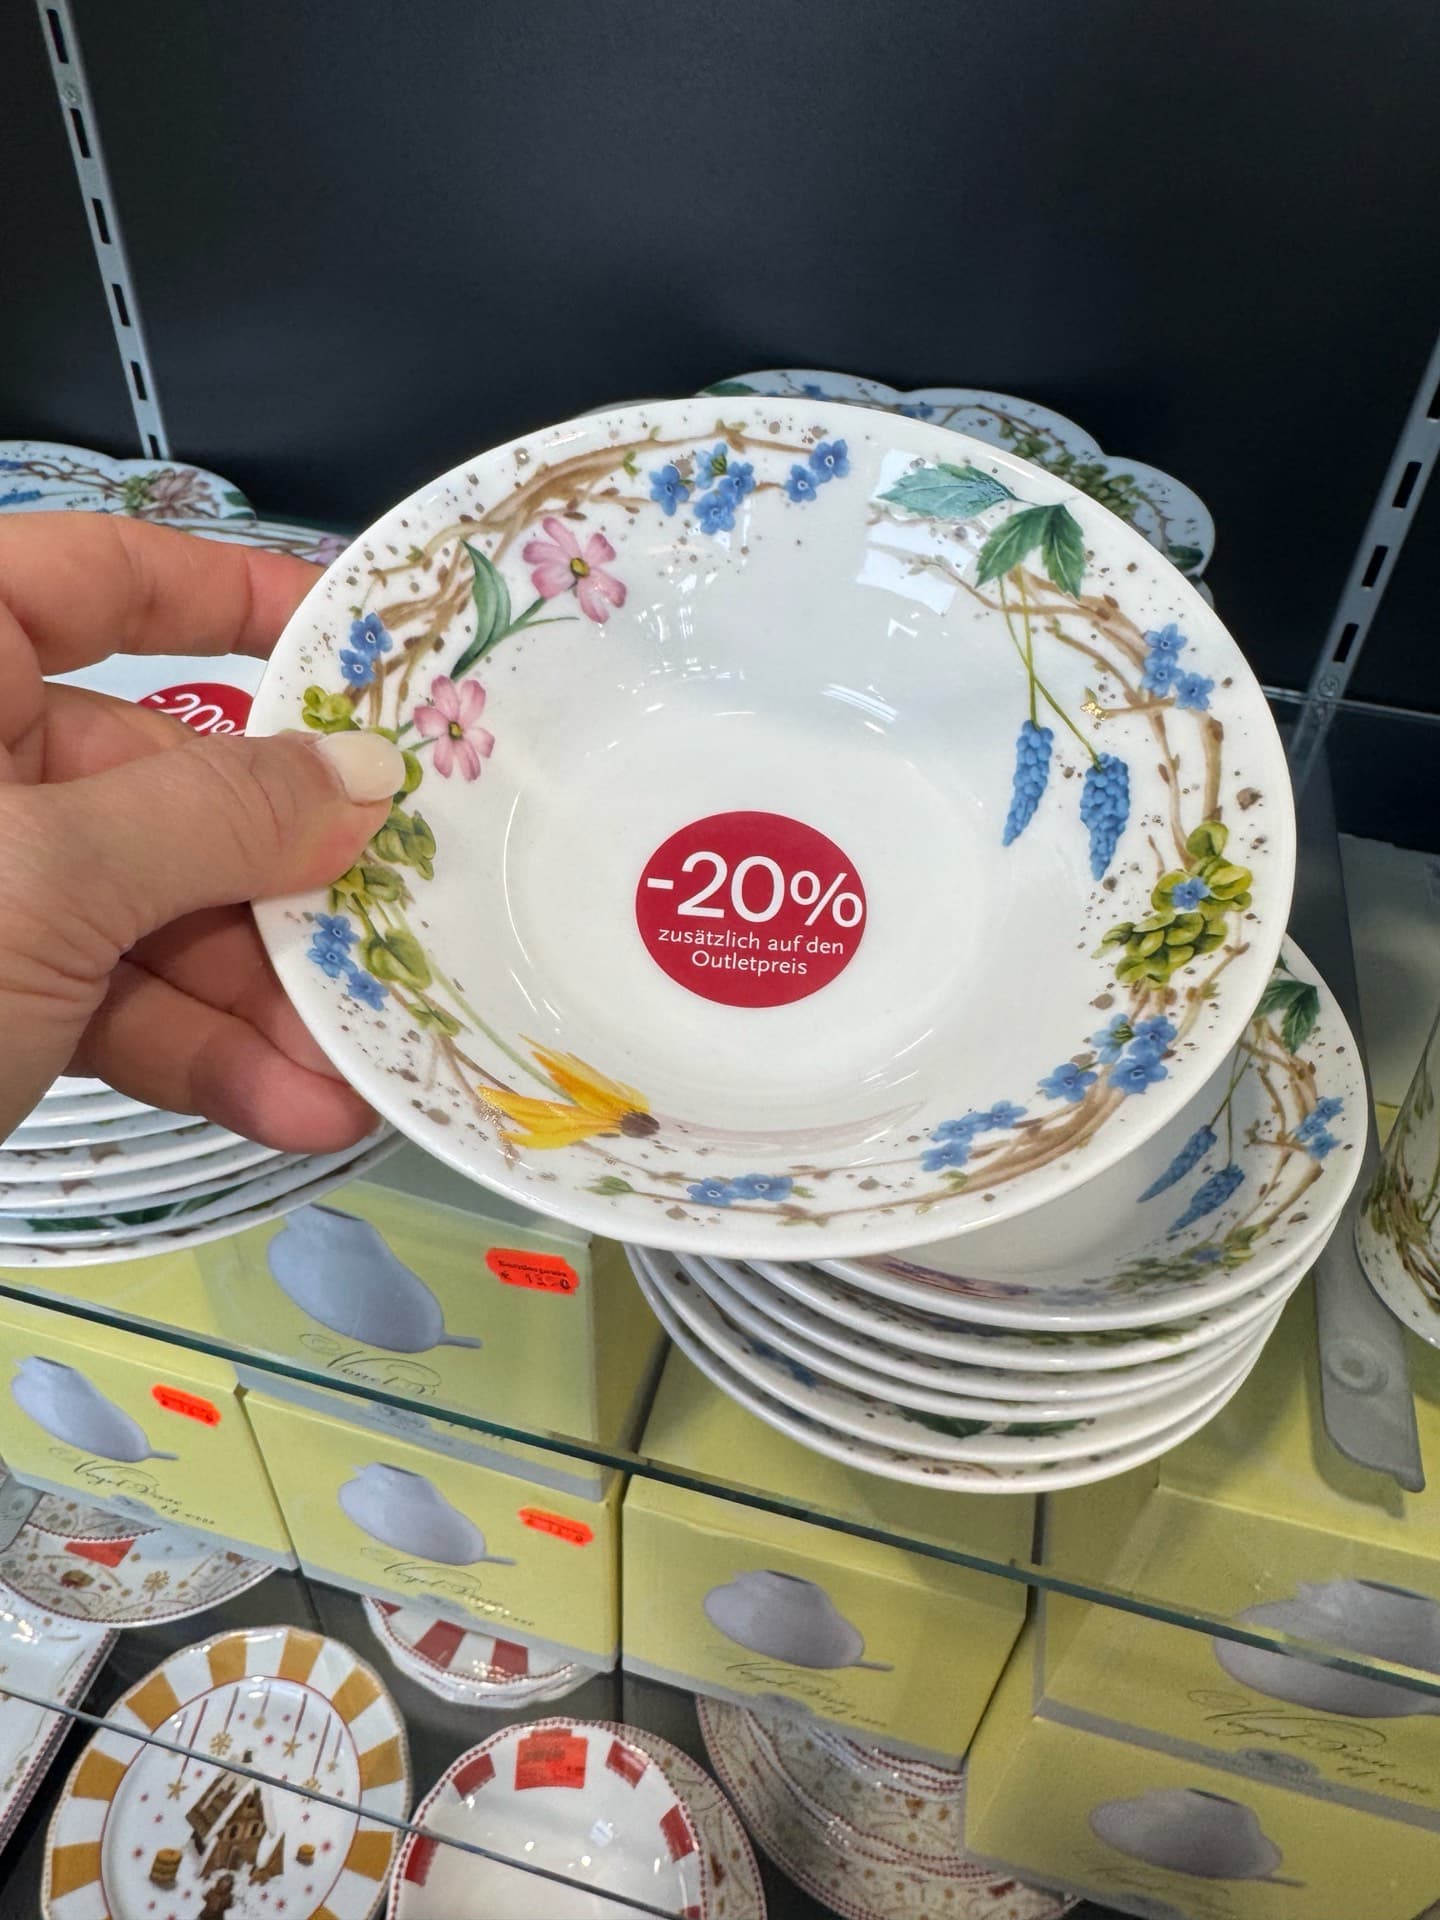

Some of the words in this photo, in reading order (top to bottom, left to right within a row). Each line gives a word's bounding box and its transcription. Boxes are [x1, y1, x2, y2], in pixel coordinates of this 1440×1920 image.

[646, 850, 864, 928] -20%
[658, 928, 760, 950] zusätzlich
[767, 934, 804, 952] auf
[806, 935, 845, 955] den
[691, 950, 808, 977] Outletpreis
